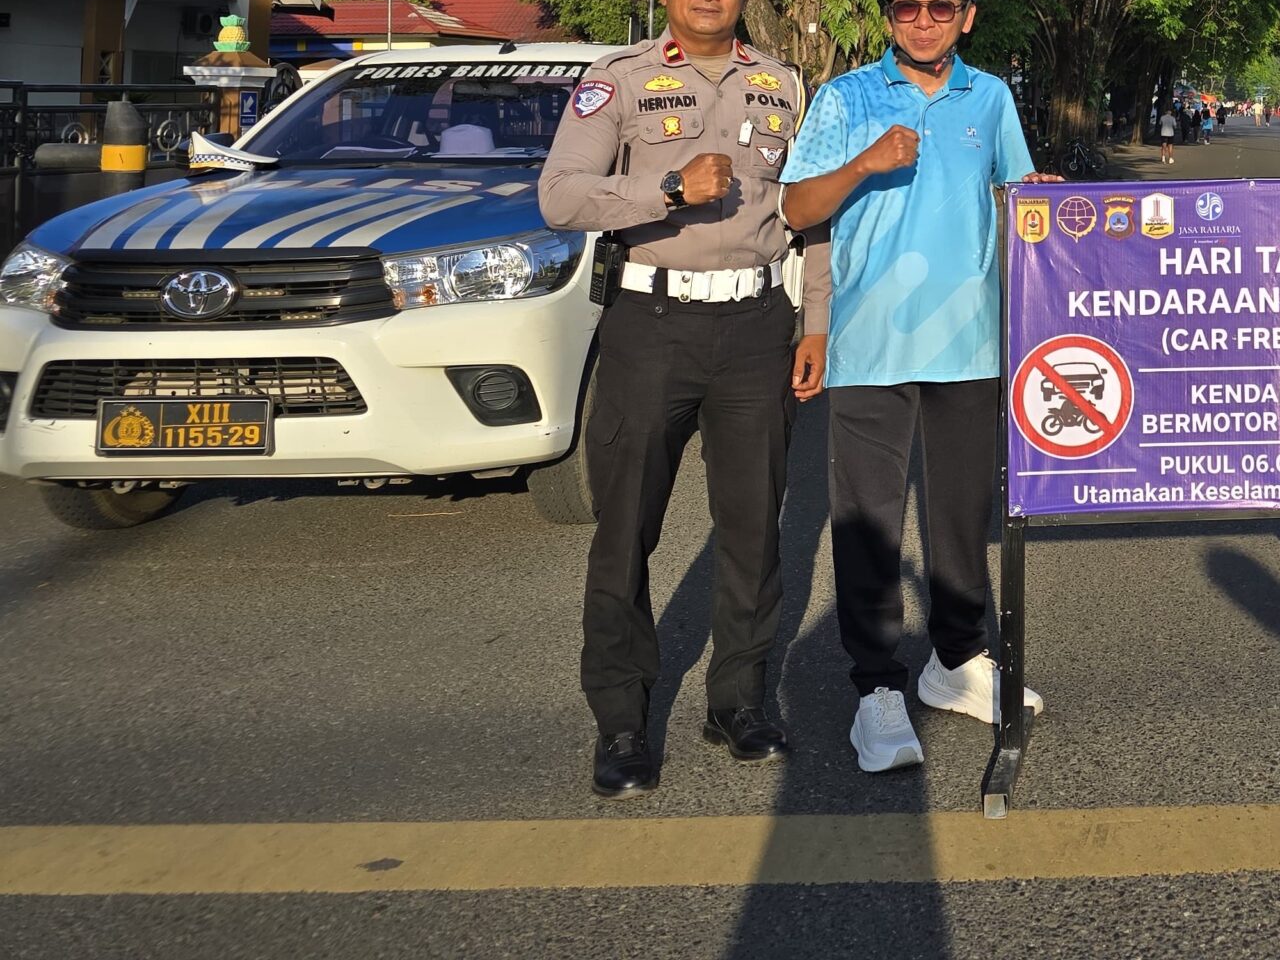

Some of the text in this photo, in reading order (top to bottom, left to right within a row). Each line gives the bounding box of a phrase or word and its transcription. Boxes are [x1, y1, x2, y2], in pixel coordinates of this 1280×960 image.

[354, 65, 448, 80] POLRES
[638, 95, 697, 112] HERIYADI
[744, 93, 793, 111] POLRI
[1178, 226, 1199, 236] JASA
[1200, 225, 1241, 235] RAHARJA
[1160, 246, 1242, 276] HARI
[1068, 286, 1280, 318] KENDARAAN
[1162, 327, 1229, 355] (CAR
[186, 403, 231, 423] XIII
[1142, 411, 1279, 435] BERMOTOR
[165, 426, 260, 448] 1155-29
[1160, 454, 1236, 476] PUKUL
[1073, 482, 1185, 505] Utamakan
